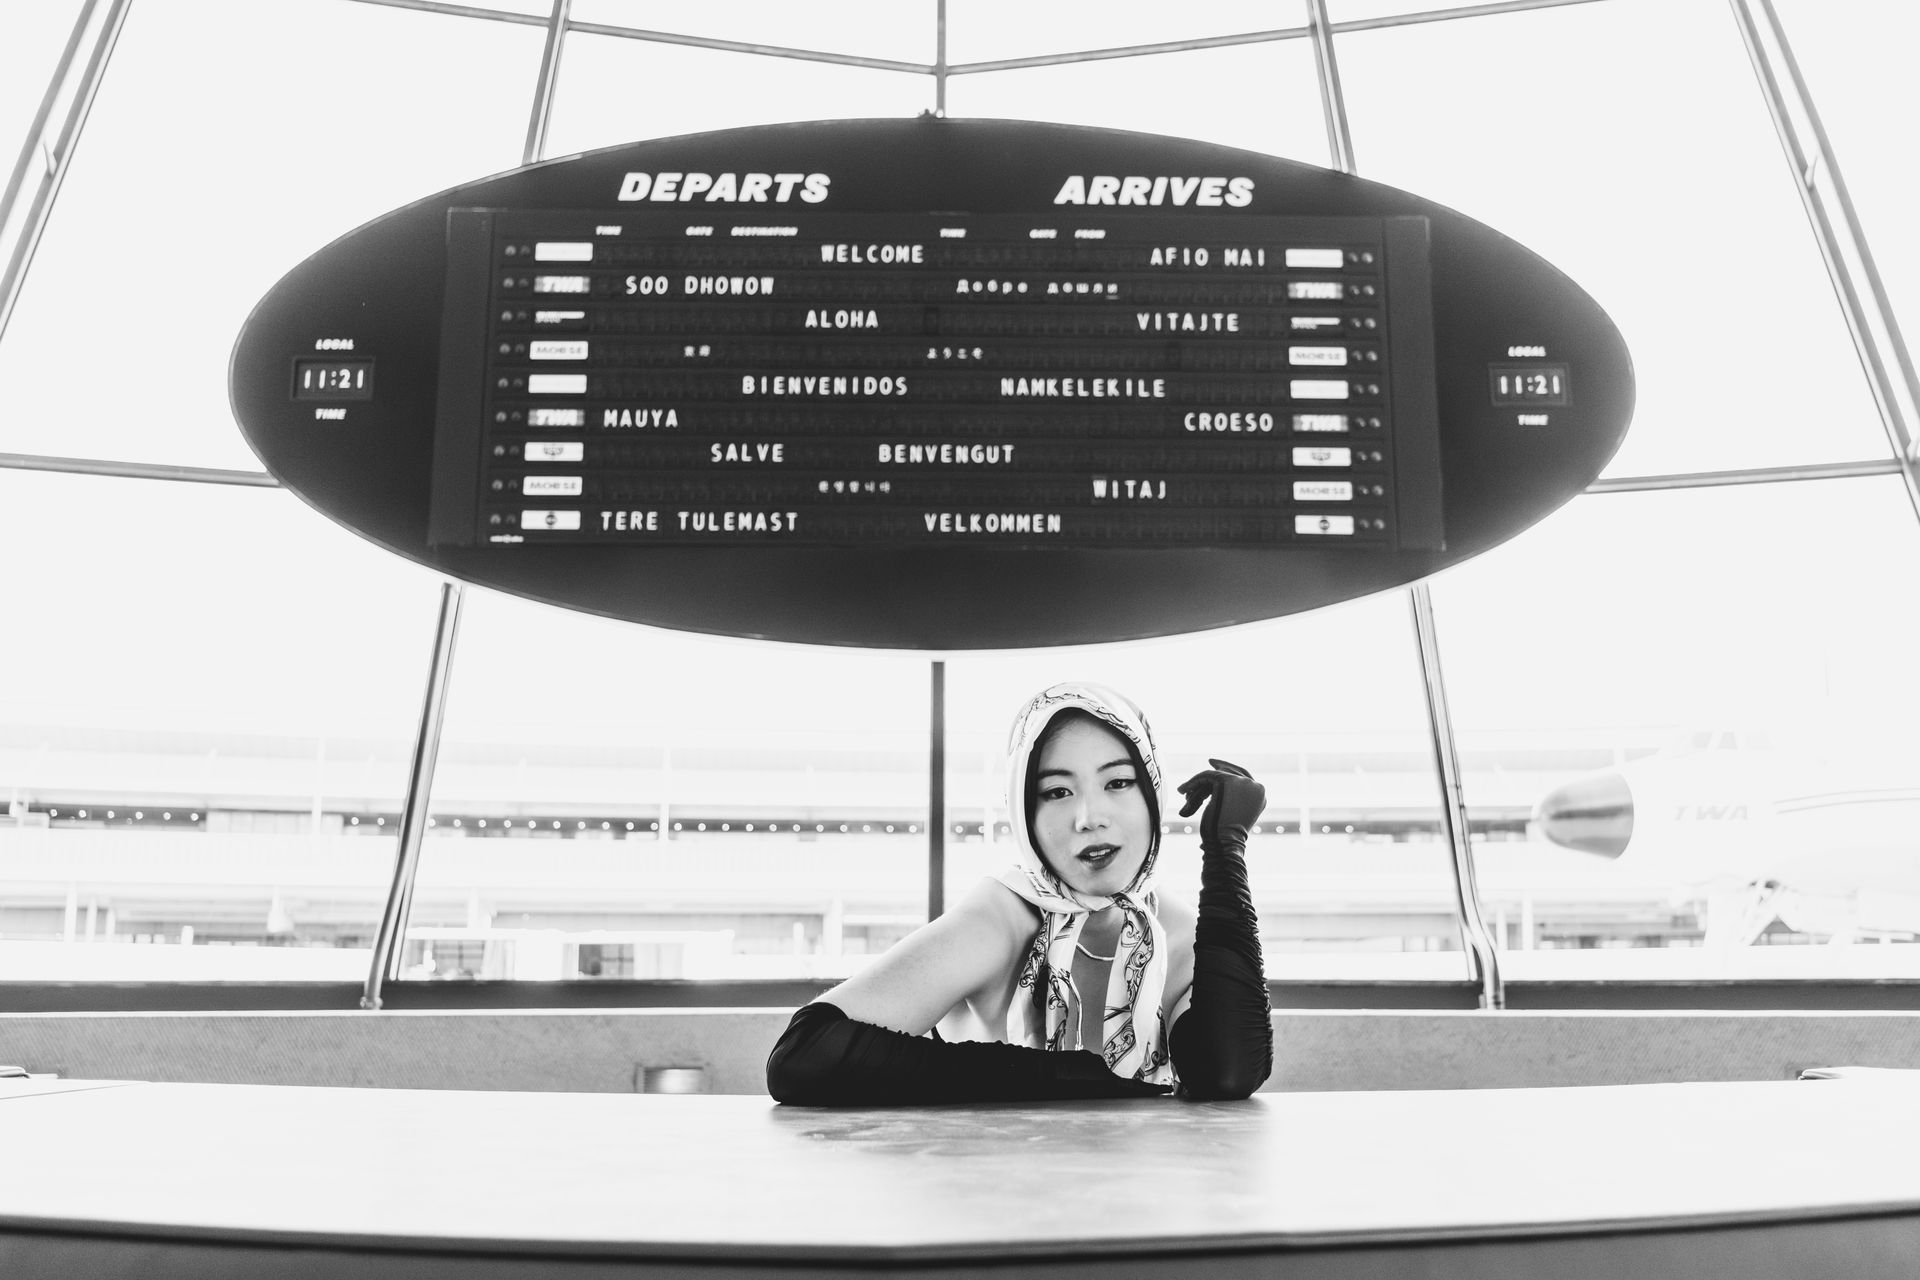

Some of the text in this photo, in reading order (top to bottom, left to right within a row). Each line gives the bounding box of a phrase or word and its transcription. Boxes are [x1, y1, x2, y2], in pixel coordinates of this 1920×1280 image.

[618, 172, 830, 203] DEPARTS
[1054, 176, 1255, 207] ARRIVES
[821, 244, 923, 263] WELCOME
[1150, 247, 1264, 266] AFIO MAI
[626, 276, 774, 295] SOO DHOWOW
[805, 310, 878, 328] ALOHA
[1137, 313, 1238, 331] VITAJTE
[304, 369, 363, 389] 11:21
[743, 376, 907, 395] BIENVENIDOS
[1001, 378, 1164, 397] NAMKELEKILE
[1500, 375, 1560, 394] 11:21
[604, 409, 677, 427] MAUYA
[1185, 413, 1273, 431] CROESO
[711, 444, 782, 462] SALVE
[879, 444, 1013, 463] BENVENGUT
[1093, 480, 1165, 499] WITAJ
[601, 511, 797, 531] TERE TULEMAST
[925, 513, 1060, 532] VELKOMMEN
